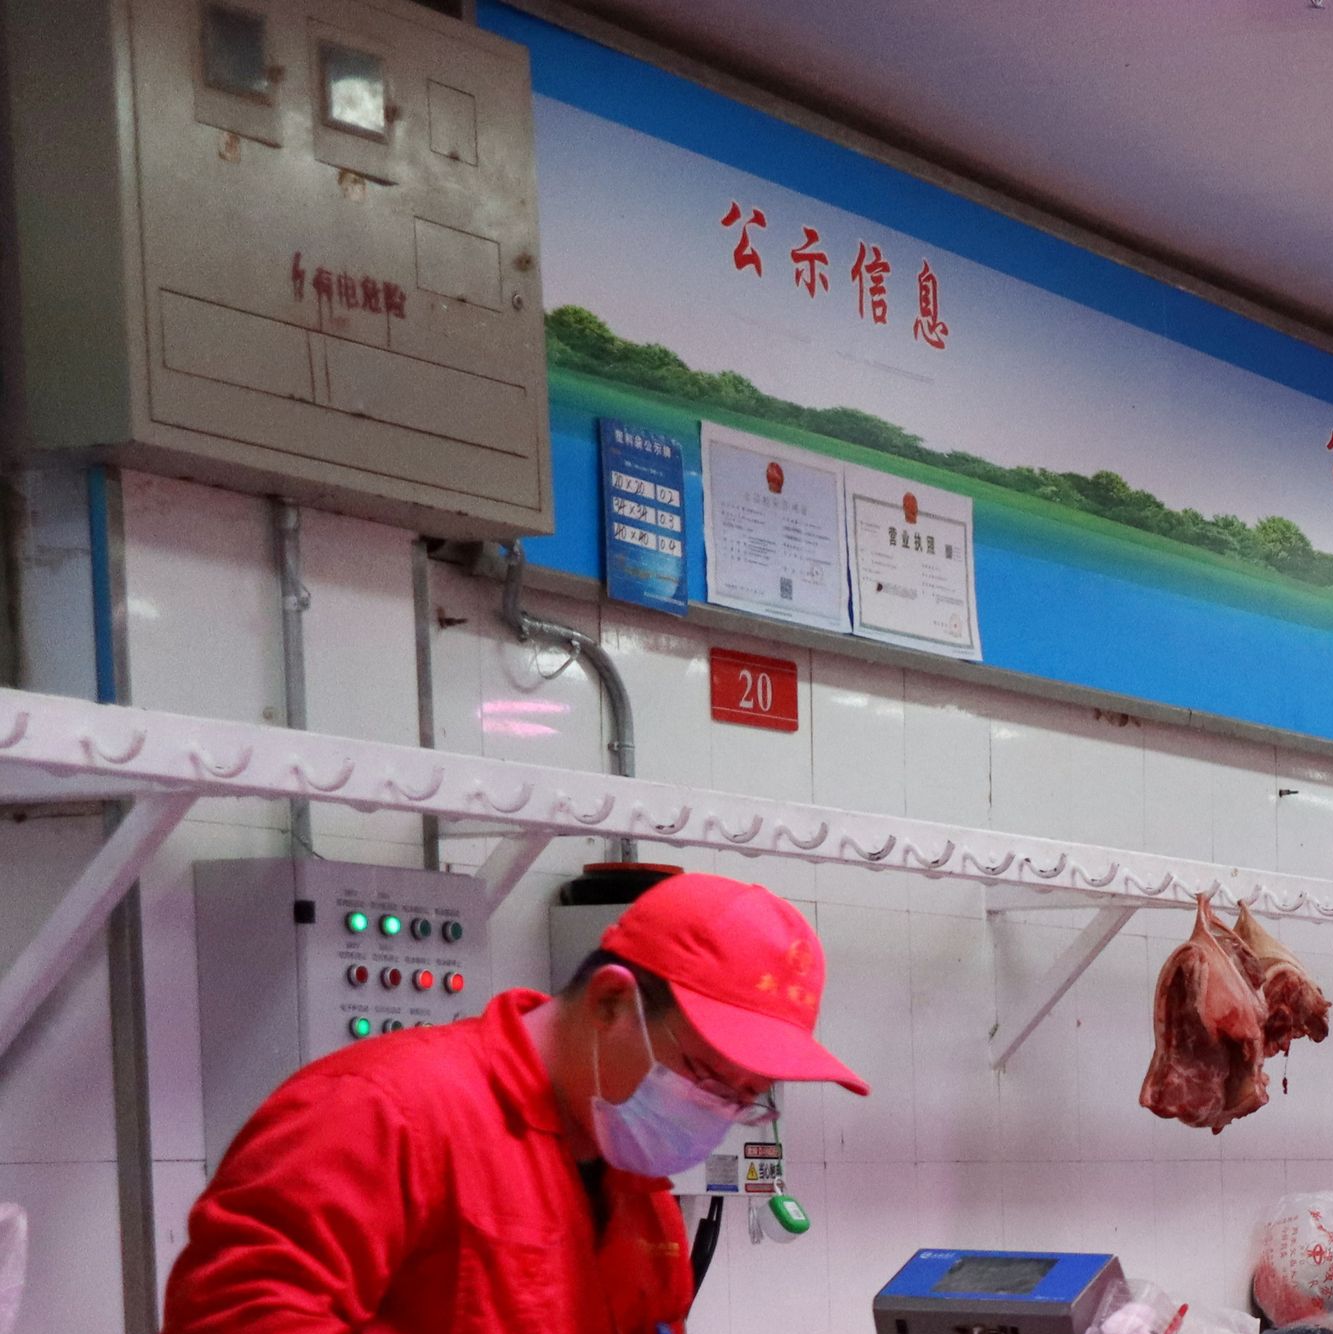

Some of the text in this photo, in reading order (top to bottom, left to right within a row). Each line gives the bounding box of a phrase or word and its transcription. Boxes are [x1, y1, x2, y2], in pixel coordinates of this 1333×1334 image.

[720, 201, 949, 349] 公示信息
[888, 526, 936, 555] 营业执照
[739, 669, 772, 712] 20
